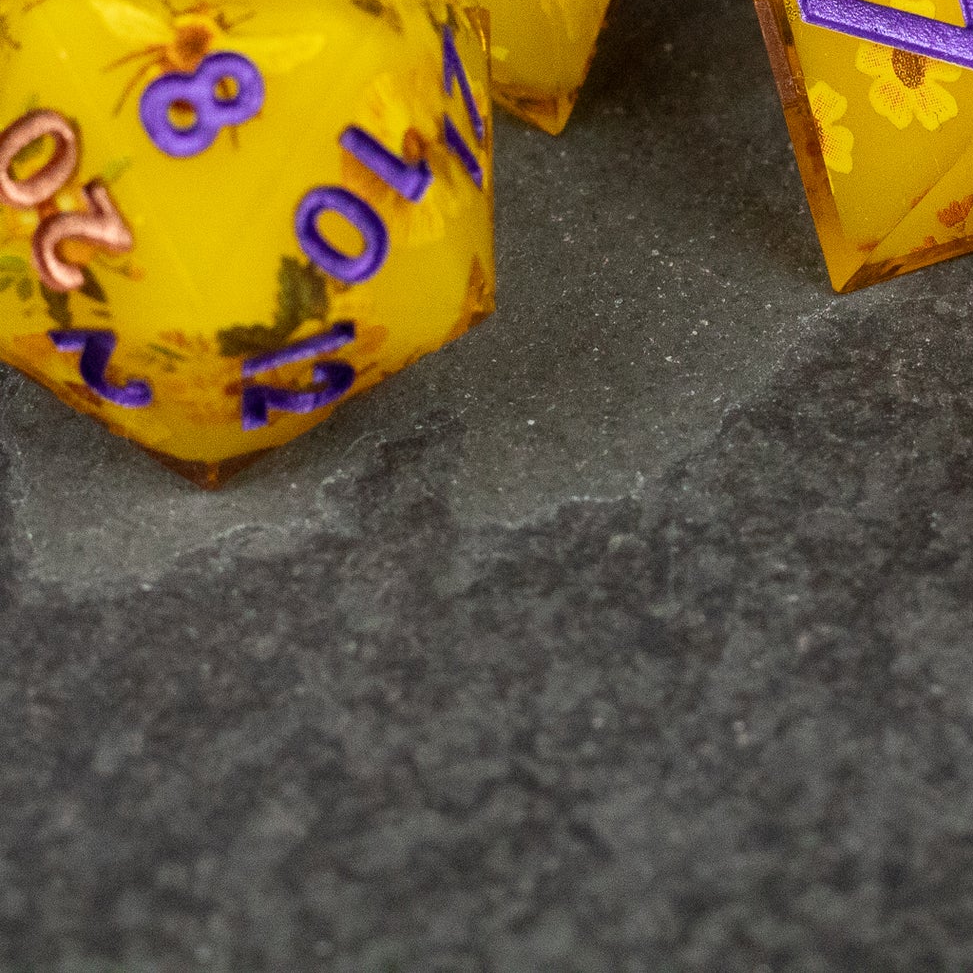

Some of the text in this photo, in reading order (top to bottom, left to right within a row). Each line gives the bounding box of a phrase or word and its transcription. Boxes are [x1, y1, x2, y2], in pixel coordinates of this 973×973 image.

[139, 51, 265, 158] 8
[0, 109, 133, 292] 20
[295, 127, 433, 284] 10
